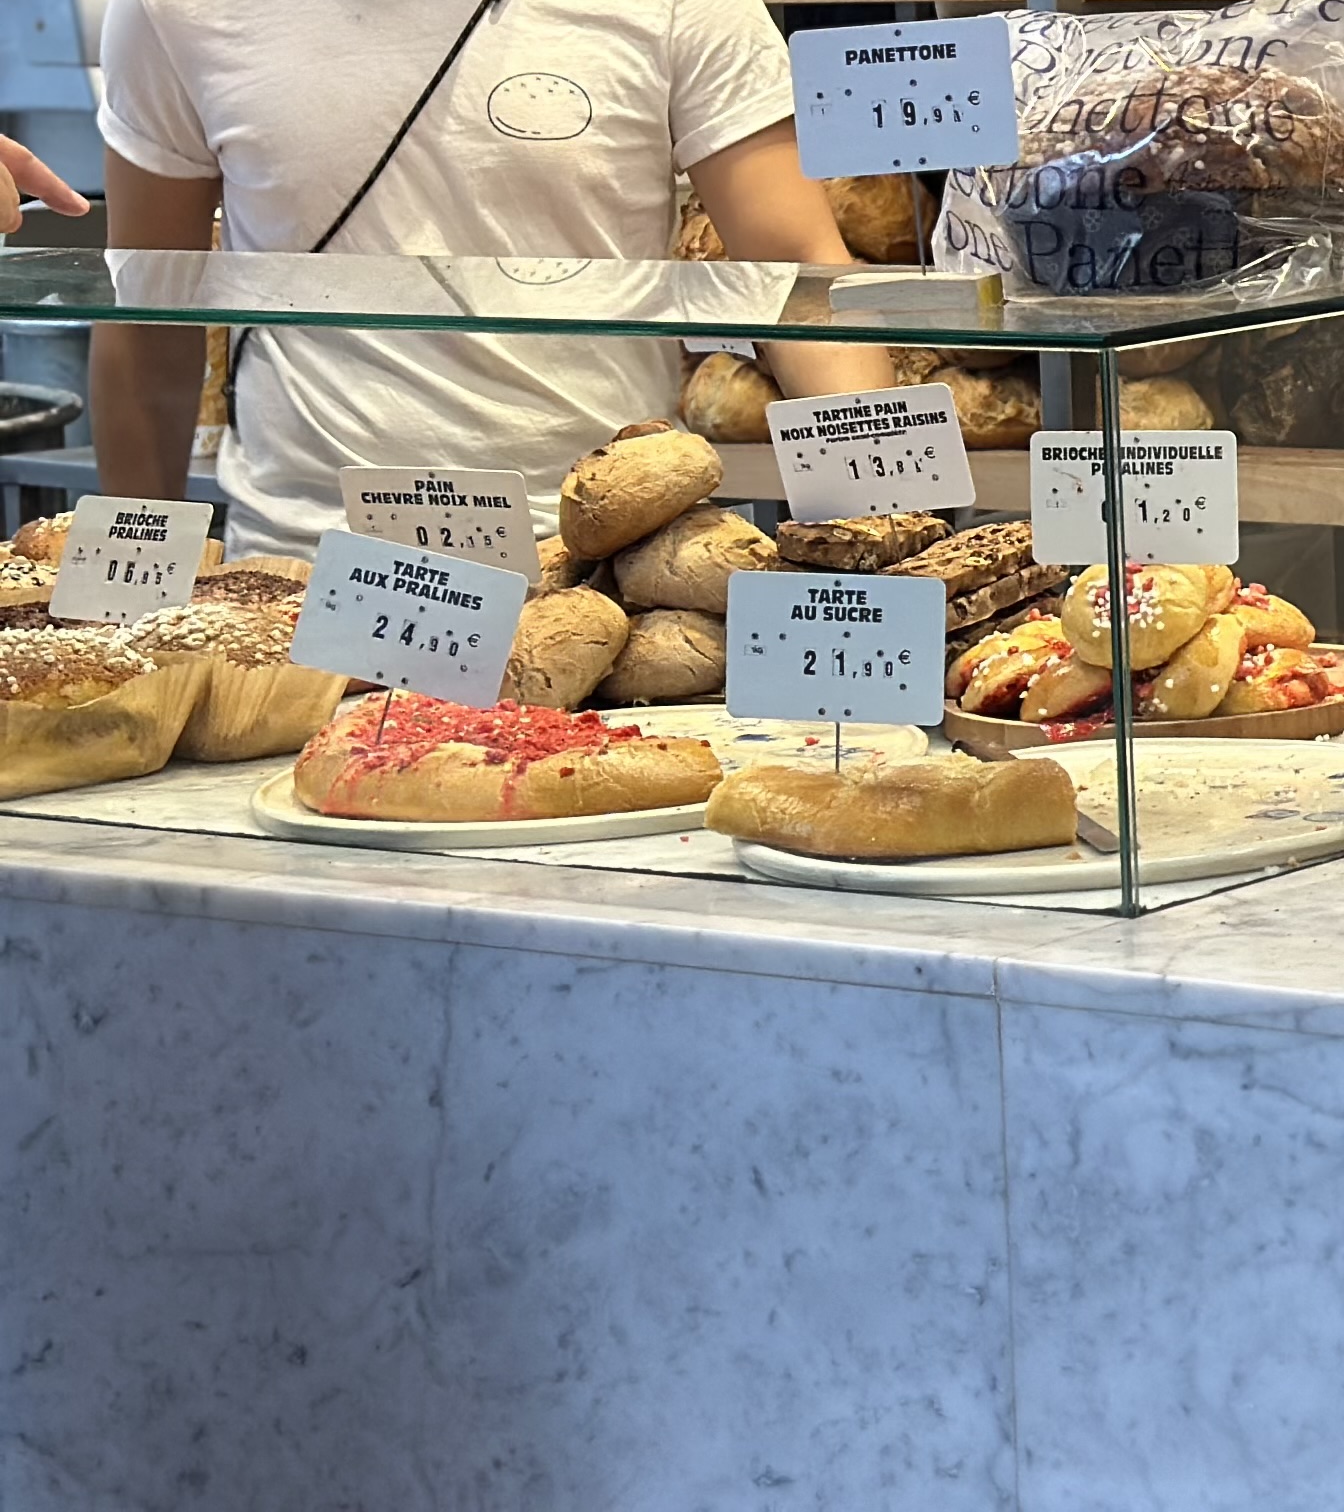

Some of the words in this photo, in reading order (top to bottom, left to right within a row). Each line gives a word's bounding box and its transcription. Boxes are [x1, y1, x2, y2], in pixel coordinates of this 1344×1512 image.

[845, 43, 956, 65] PANETTONE
[813, 405, 872, 423] TARTINE
[874, 401, 908, 416] PAIN
[780, 427, 814, 441] NOIX
[817, 418, 890, 437] NOISETTES
[893, 411, 947, 430] RAISINS
[1121, 446, 1223, 460] INDIVIDUELLE
[414, 480, 454, 493] PAIN
[361, 492, 424, 505] CHEVRE
[428, 494, 468, 507] NOIX
[473, 495, 512, 508] MIEL
[115, 512, 169, 527] BRIOCHE
[109, 526, 168, 541] PRALINES
[393, 560, 450, 586] TARTE
[349, 567, 389, 589] AUX
[392, 577, 484, 611] PRALINES
[807, 588, 867, 605] TARTE
[791, 605, 817, 620] AU
[823, 606, 882, 623] SUCRE
